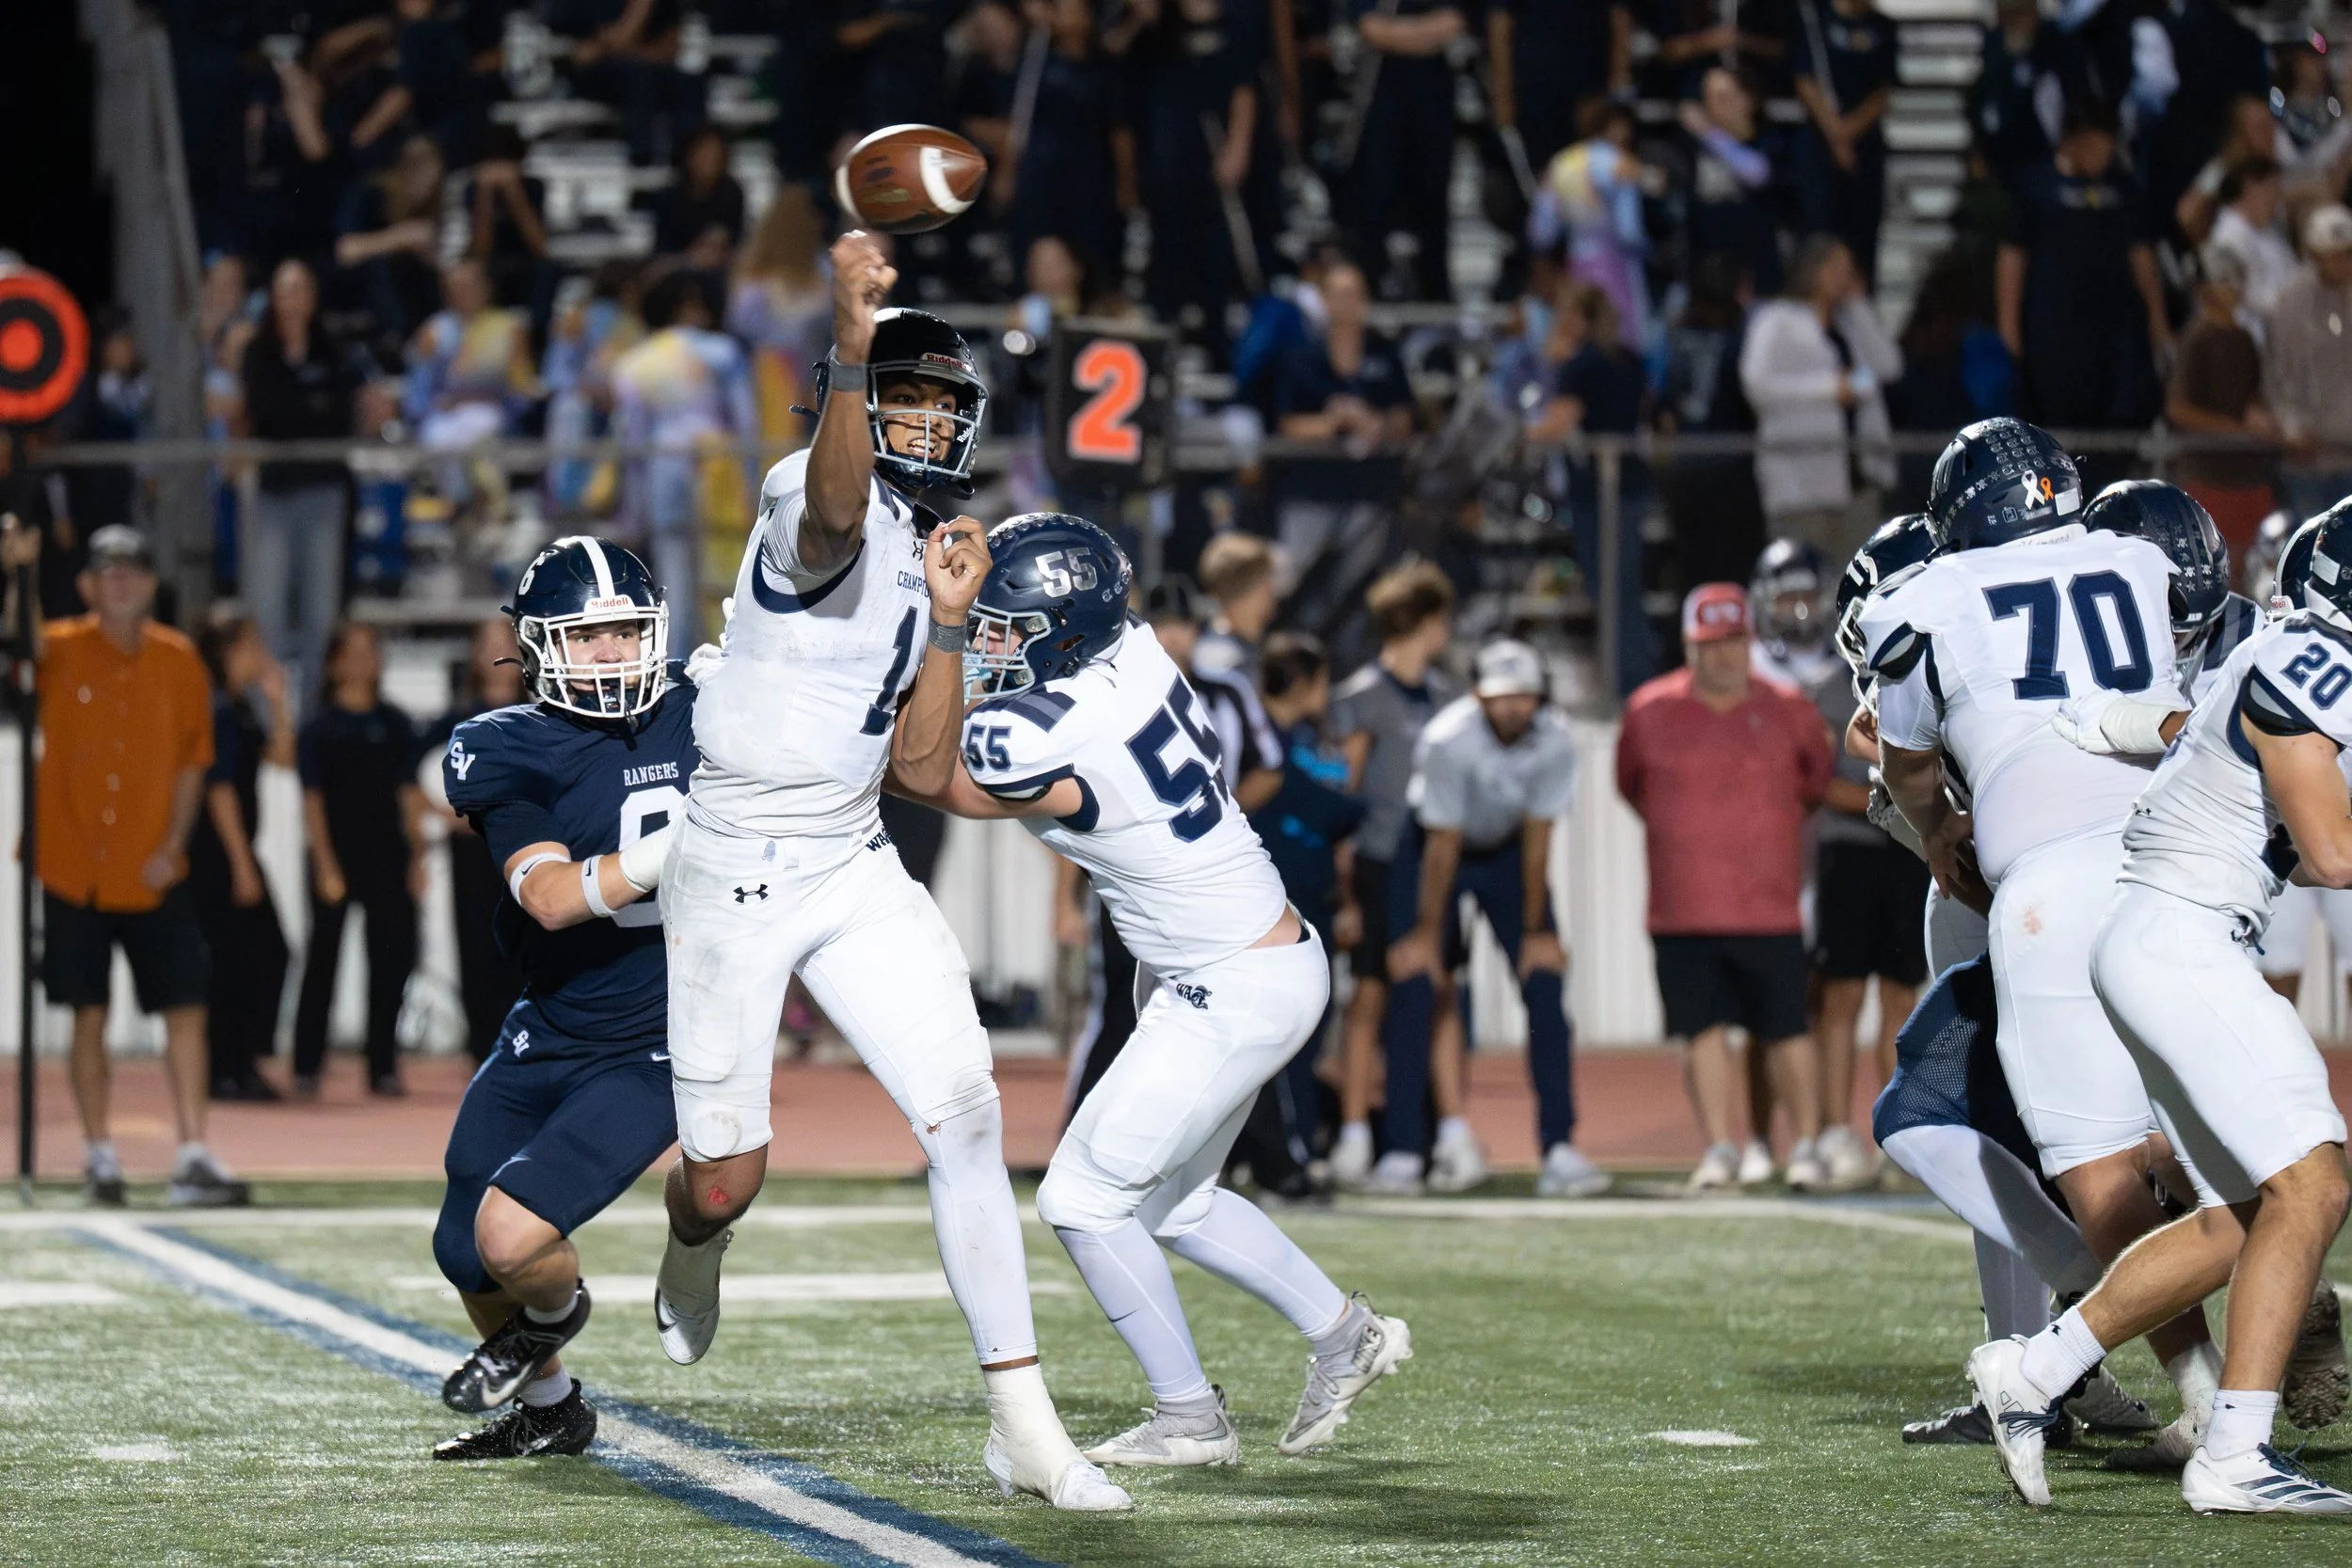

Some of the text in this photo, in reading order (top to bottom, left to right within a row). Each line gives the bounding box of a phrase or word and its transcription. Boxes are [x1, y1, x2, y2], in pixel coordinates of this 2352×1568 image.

[926, 353, 964, 370] Riddell
[1068, 340, 1147, 461] 2
[1035, 546, 1098, 598] 55
[590, 596, 628, 609] Riddell
[1980, 569, 2154, 701] 70
[859, 605, 918, 736] 1
[2279, 642, 2352, 711] 20
[450, 741, 476, 781] SV
[964, 722, 1012, 773] 55
[1124, 671, 1229, 844] 55
[623, 761, 679, 786] RANGERS
[512, 1029, 530, 1057] SV
